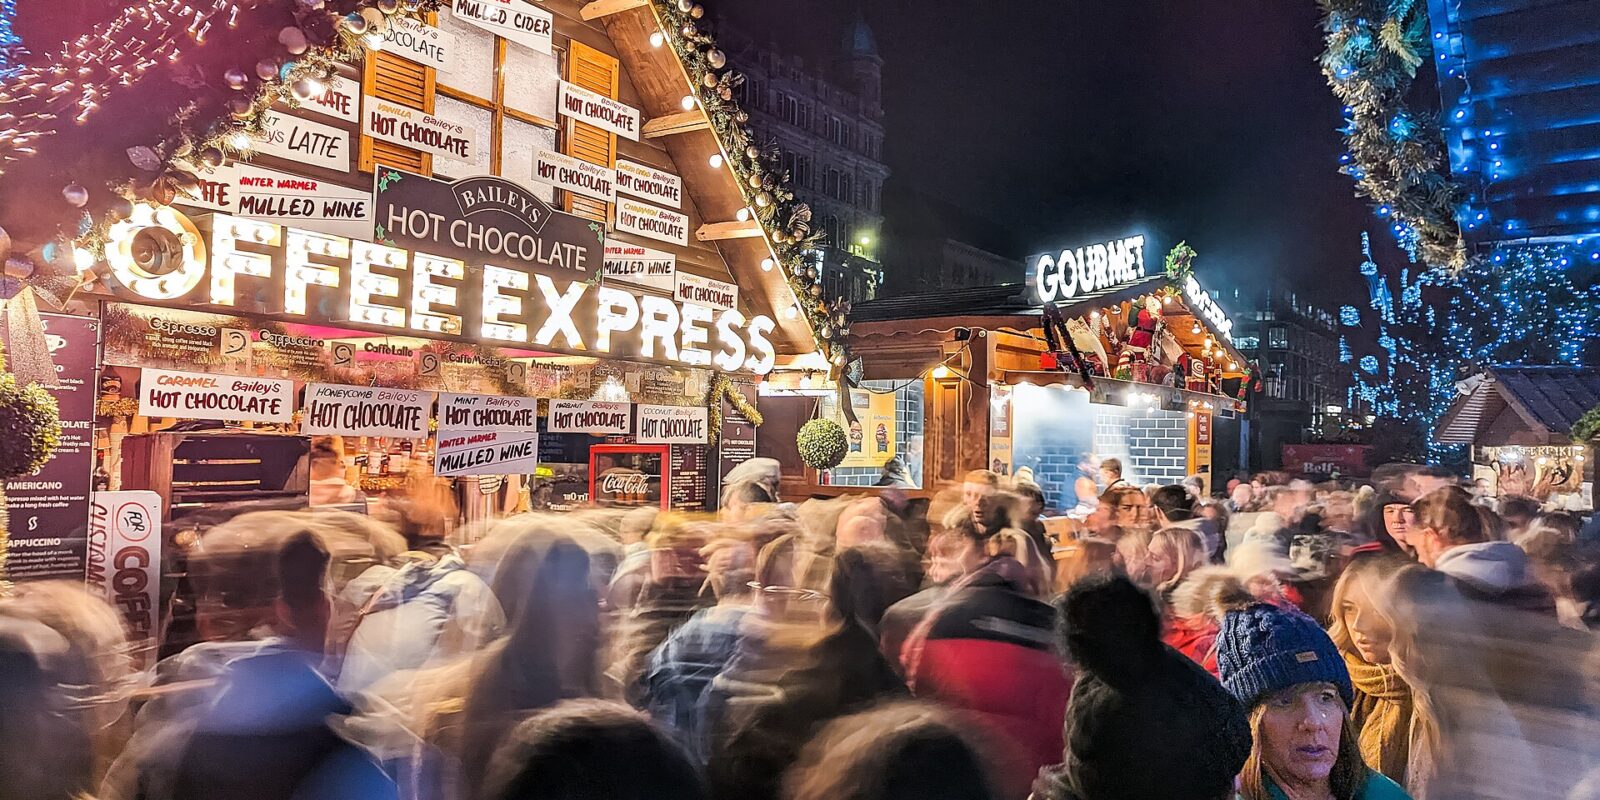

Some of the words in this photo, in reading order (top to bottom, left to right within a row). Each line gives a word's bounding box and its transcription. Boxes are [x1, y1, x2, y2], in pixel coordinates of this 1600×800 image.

[456, 0, 507, 24] MULLED
[514, 13, 550, 35] CIDER
[385, 28, 445, 63] OCOLATE
[377, 103, 412, 119] VANILLA
[565, 93, 583, 115] HOT
[585, 101, 634, 132] CHOCOLATE
[288, 126, 342, 158] LATTE
[370, 111, 398, 137] HOT
[400, 121, 470, 158] CHOCOLATE
[277, 179, 317, 191] WARMER
[537, 159, 556, 180] HOT
[559, 167, 612, 197] CHOCOLATE
[616, 169, 632, 188] HOT
[633, 178, 679, 202] CHOCOLATE
[239, 195, 315, 217] MULLED
[323, 200, 366, 218] WINE
[461, 185, 541, 224] BAILEYS
[620, 211, 637, 228] HOT
[638, 217, 684, 240] CHOCOLATE
[387, 204, 445, 242] HOT
[450, 219, 587, 272] CHOCOLATE
[623, 247, 645, 256] WARMER
[604, 260, 644, 275] MULLED
[648, 261, 672, 275] WINE
[1036, 234, 1145, 303] GOURMET
[104, 203, 465, 335] OFFEE
[481, 264, 776, 375] EXPRESS
[679, 282, 693, 300] HOT
[695, 287, 734, 309] CHOCOLATE
[149, 316, 216, 336] Espresso
[259, 330, 325, 347] Cappuccino
[156, 374, 219, 388] CARAMEL
[149, 389, 182, 409] HOT
[185, 393, 282, 415] CHOCOLATE
[315, 387, 374, 398] HONEYCOMB
[453, 396, 479, 406] MINT
[310, 399, 342, 429] HOT
[343, 400, 423, 432] CHOCOLATE
[445, 405, 469, 427] HOT
[473, 408, 533, 427] CHOCOLATE
[554, 411, 573, 429] HOT
[574, 411, 626, 430] CHOCOLATE
[643, 407, 672, 415] COCONUT
[641, 417, 657, 438] HOT
[659, 418, 703, 439] CHOCOLATE
[438, 436, 465, 449] WINTER
[467, 433, 497, 445] WARMER
[438, 447, 494, 473] MULLED
[499, 441, 533, 461] WINE
[6, 481, 62, 490] AMERICANO
[126, 511, 145, 532] FOR
[8, 538, 61, 547] APPUCCINO
